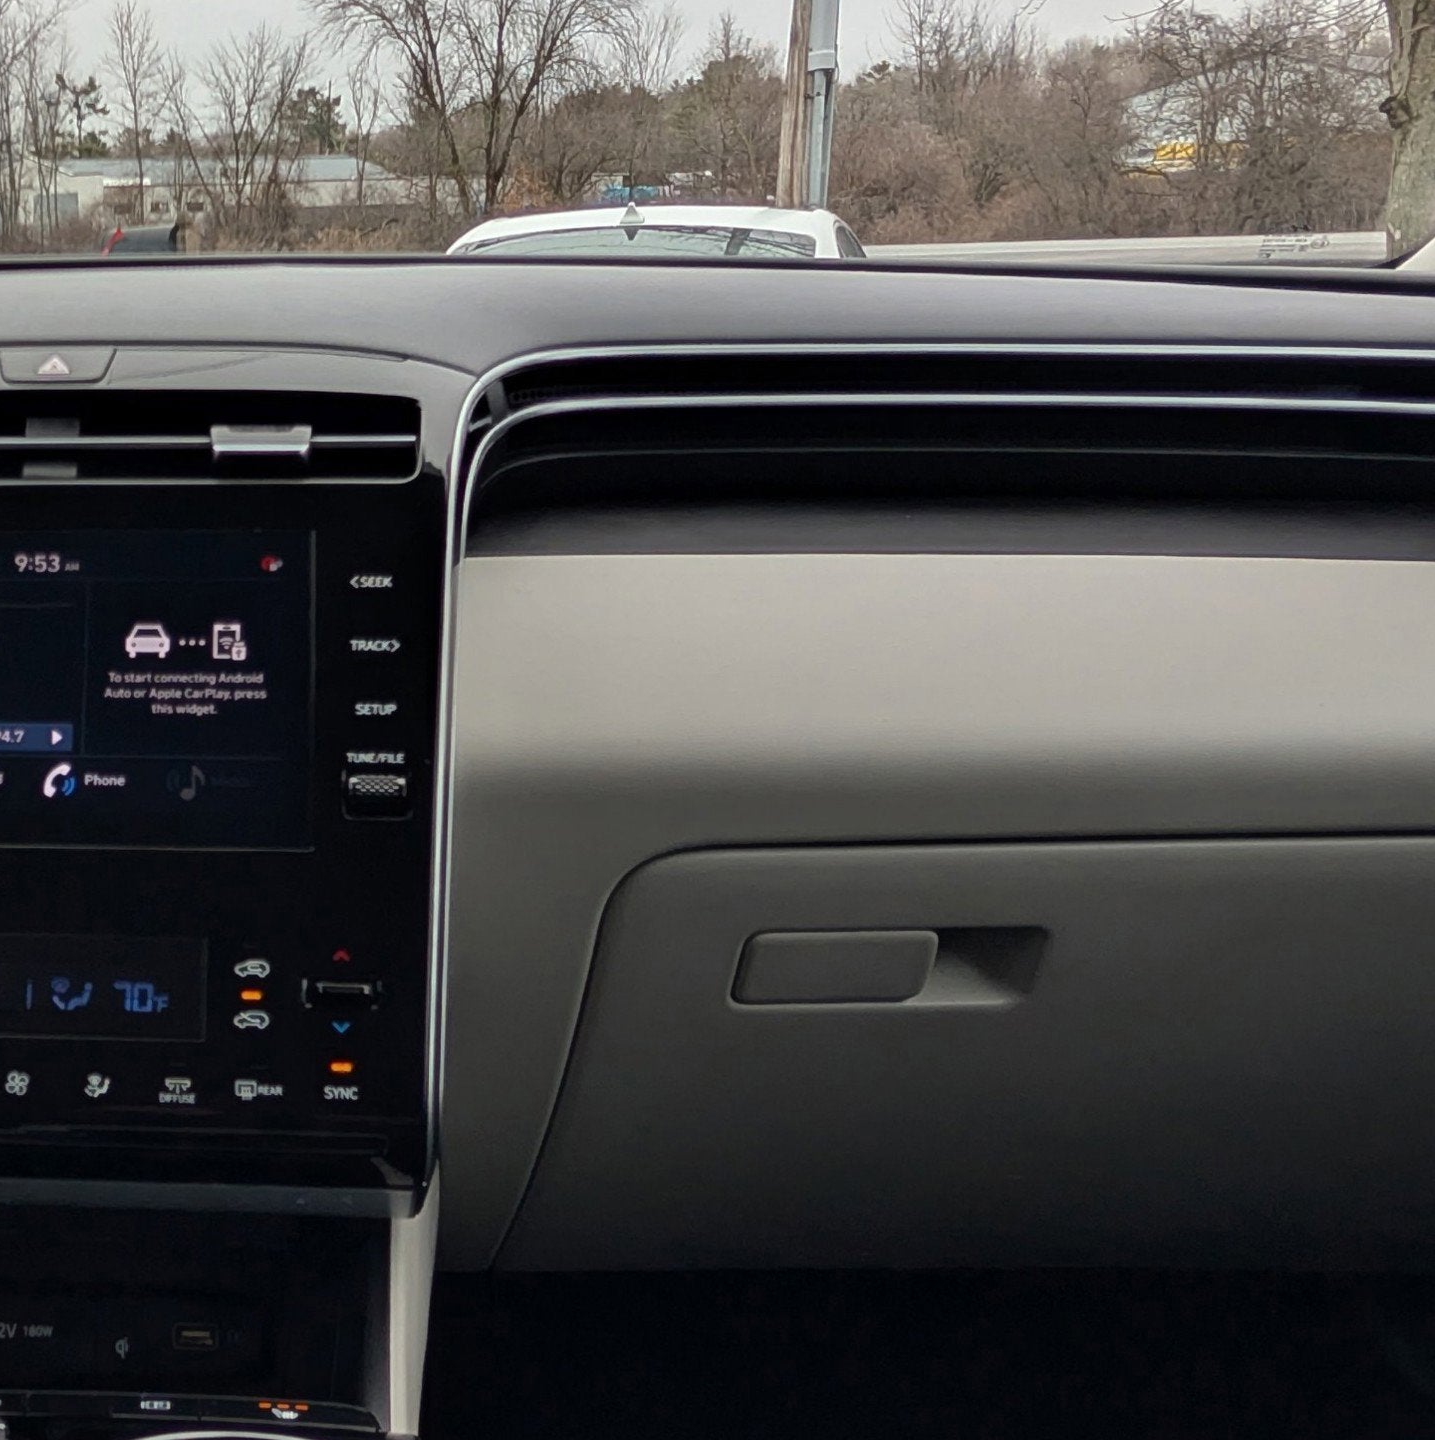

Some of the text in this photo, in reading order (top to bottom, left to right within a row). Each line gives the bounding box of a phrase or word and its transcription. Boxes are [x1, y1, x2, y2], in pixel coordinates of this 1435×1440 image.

[13, 553, 62, 574] 9:53
[359, 575, 394, 590] SEEK
[349, 639, 389, 653] TRACK
[107, 671, 265, 686] To start connecting Android
[103, 687, 133, 700] Auto
[133, 689, 148, 700] or
[148, 688, 183, 702] Apple
[233, 689, 268, 702] press
[150, 703, 219, 717] this widget.
[354, 702, 399, 717] SETUP
[345, 751, 406, 765] TUNE/FILE
[83, 772, 126, 787] Phone
[158, 1092, 197, 1106] DIFFUSE
[257, 1085, 284, 1098] REAR
[323, 1085, 360, 1101] SYNC
